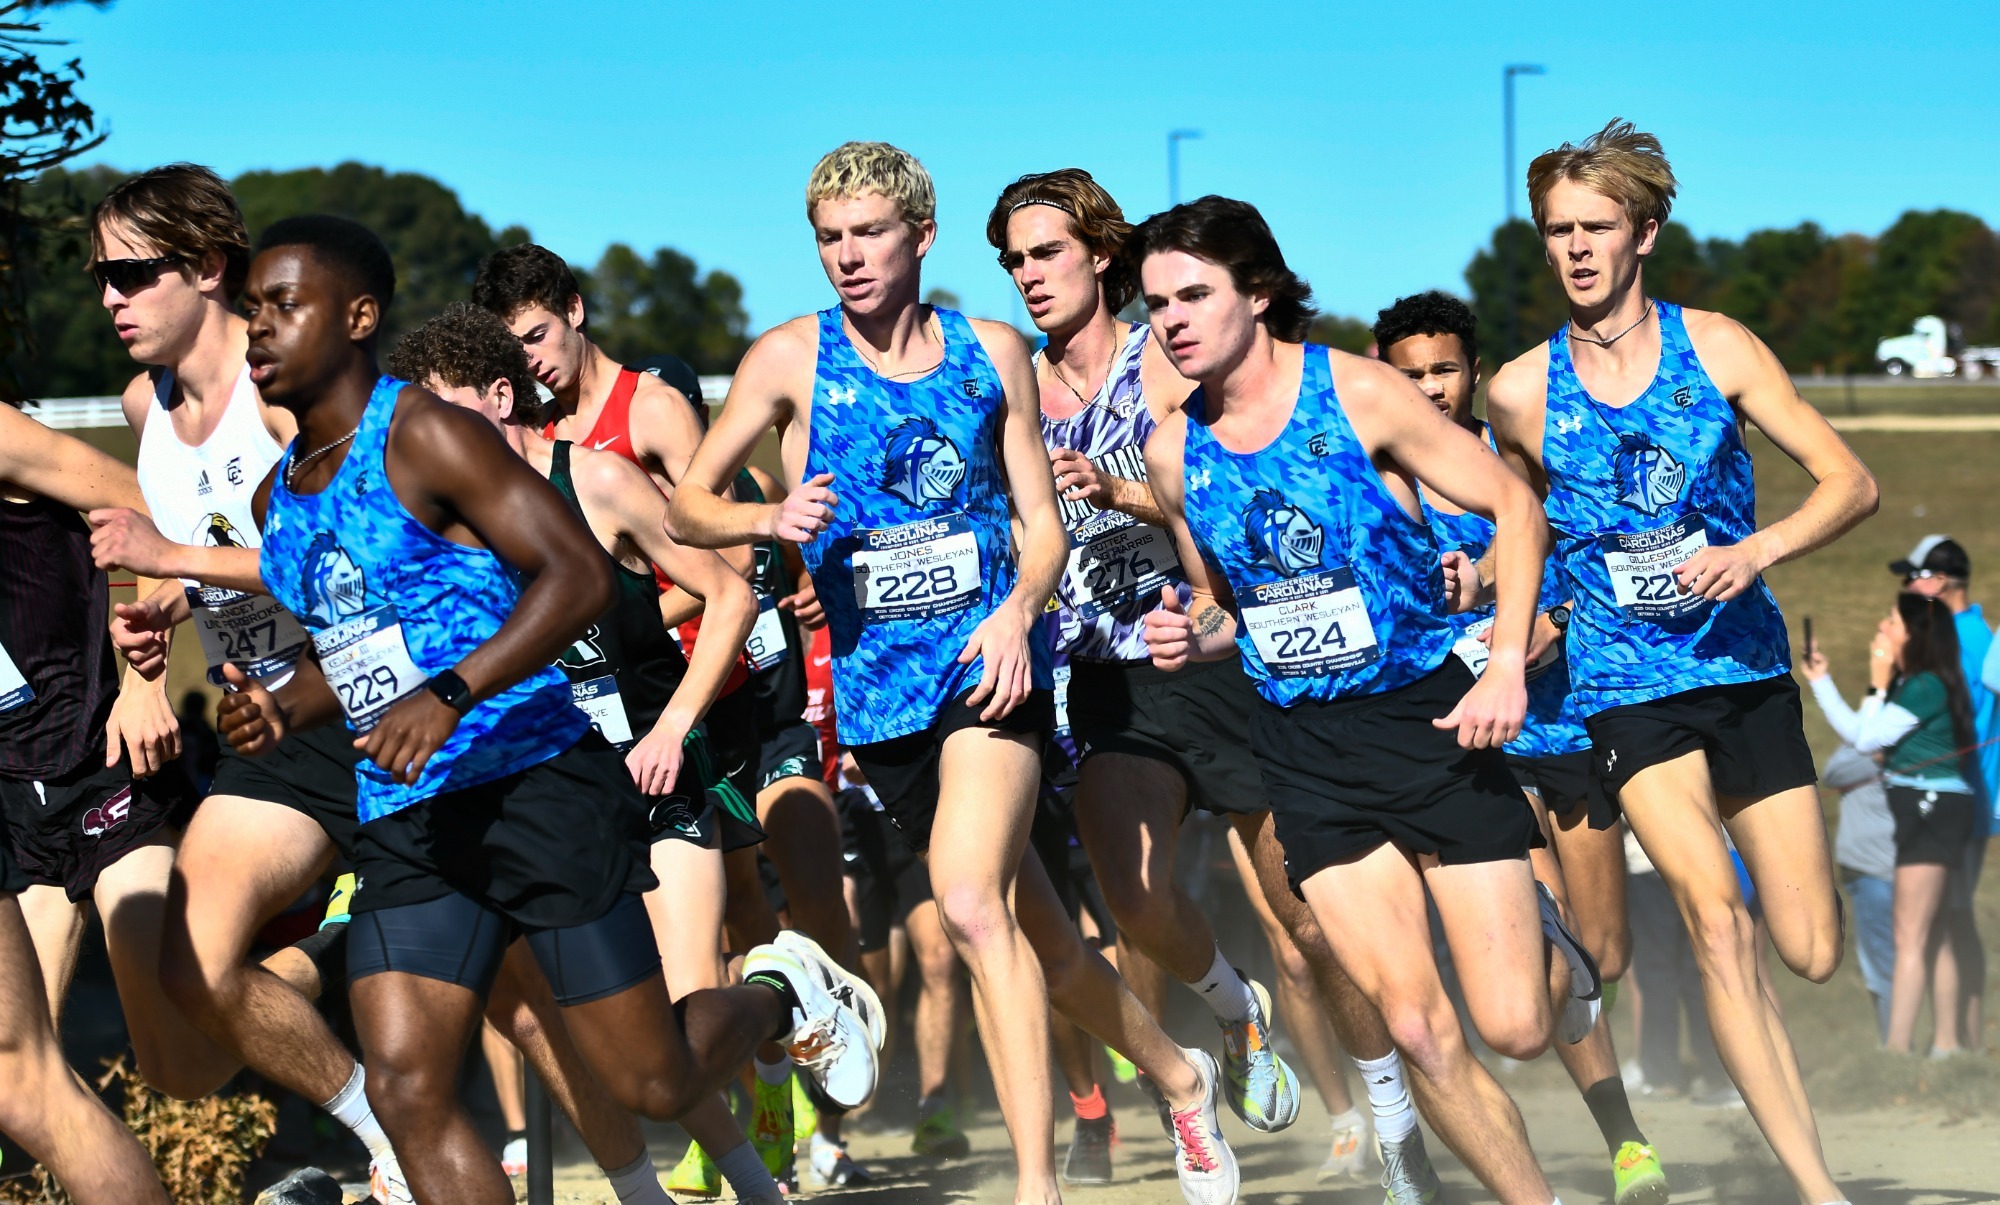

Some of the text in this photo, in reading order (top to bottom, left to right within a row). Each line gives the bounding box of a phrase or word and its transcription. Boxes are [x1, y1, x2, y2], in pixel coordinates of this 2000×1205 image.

[884, 520, 936, 535] CONFERENCE
[1085, 513, 1122, 529] CONFERENC
[1627, 524, 1675, 540] CONFERENCE
[869, 522, 949, 549] CAROLINAS
[1090, 533, 1129, 554] POTTER
[1619, 523, 1686, 550] CAROLINAS
[855, 547, 973, 574] SOUTHERN WESLEYAN
[890, 545, 933, 561] JONES
[1076, 534, 1154, 570] YOUNG HARRIS
[1611, 543, 1705, 573] SOUTHERN WESLEYAN
[1628, 545, 1683, 564] GILLESPIE
[876, 565, 958, 604] 228
[1087, 550, 1155, 595] 276
[1269, 574, 1320, 589] CONFERENCE
[1256, 577, 1334, 603] CAROLINAS
[223, 604, 285, 629] PEMBROKE
[1248, 602, 1360, 630] SOUTHERN WESLEYAN
[1278, 601, 1318, 615] CLARK
[218, 619, 277, 659] 247
[1270, 621, 1347, 659] 224
[337, 665, 398, 713] 229
